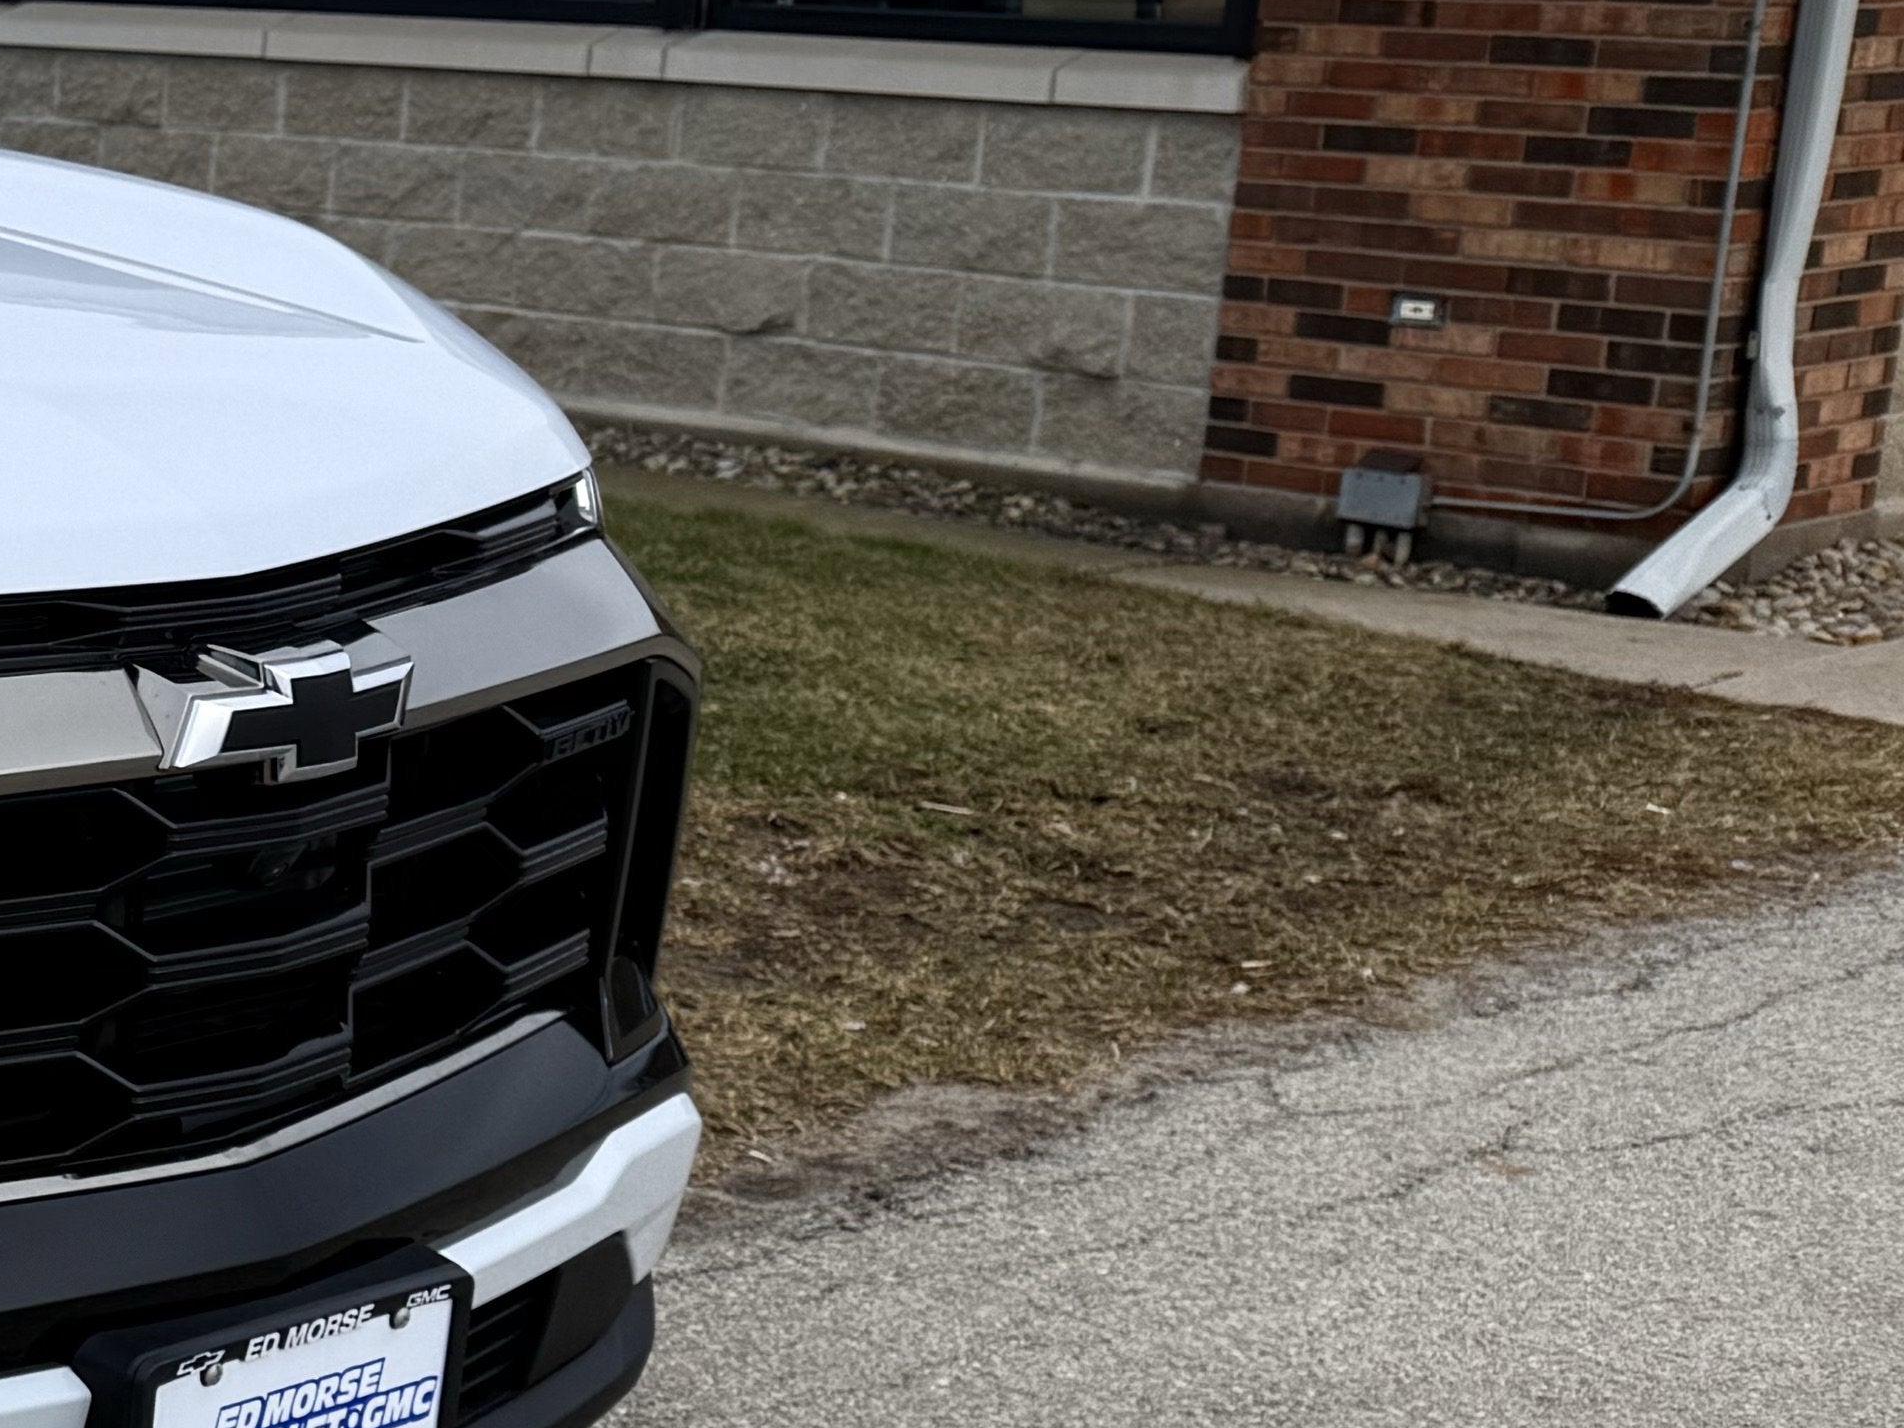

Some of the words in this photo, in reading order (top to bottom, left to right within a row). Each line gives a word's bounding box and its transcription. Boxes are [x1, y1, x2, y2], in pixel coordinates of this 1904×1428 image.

[405, 1283, 453, 1309] GMC
[244, 1331, 280, 1362] ED
[283, 1303, 376, 1351] MORSE
